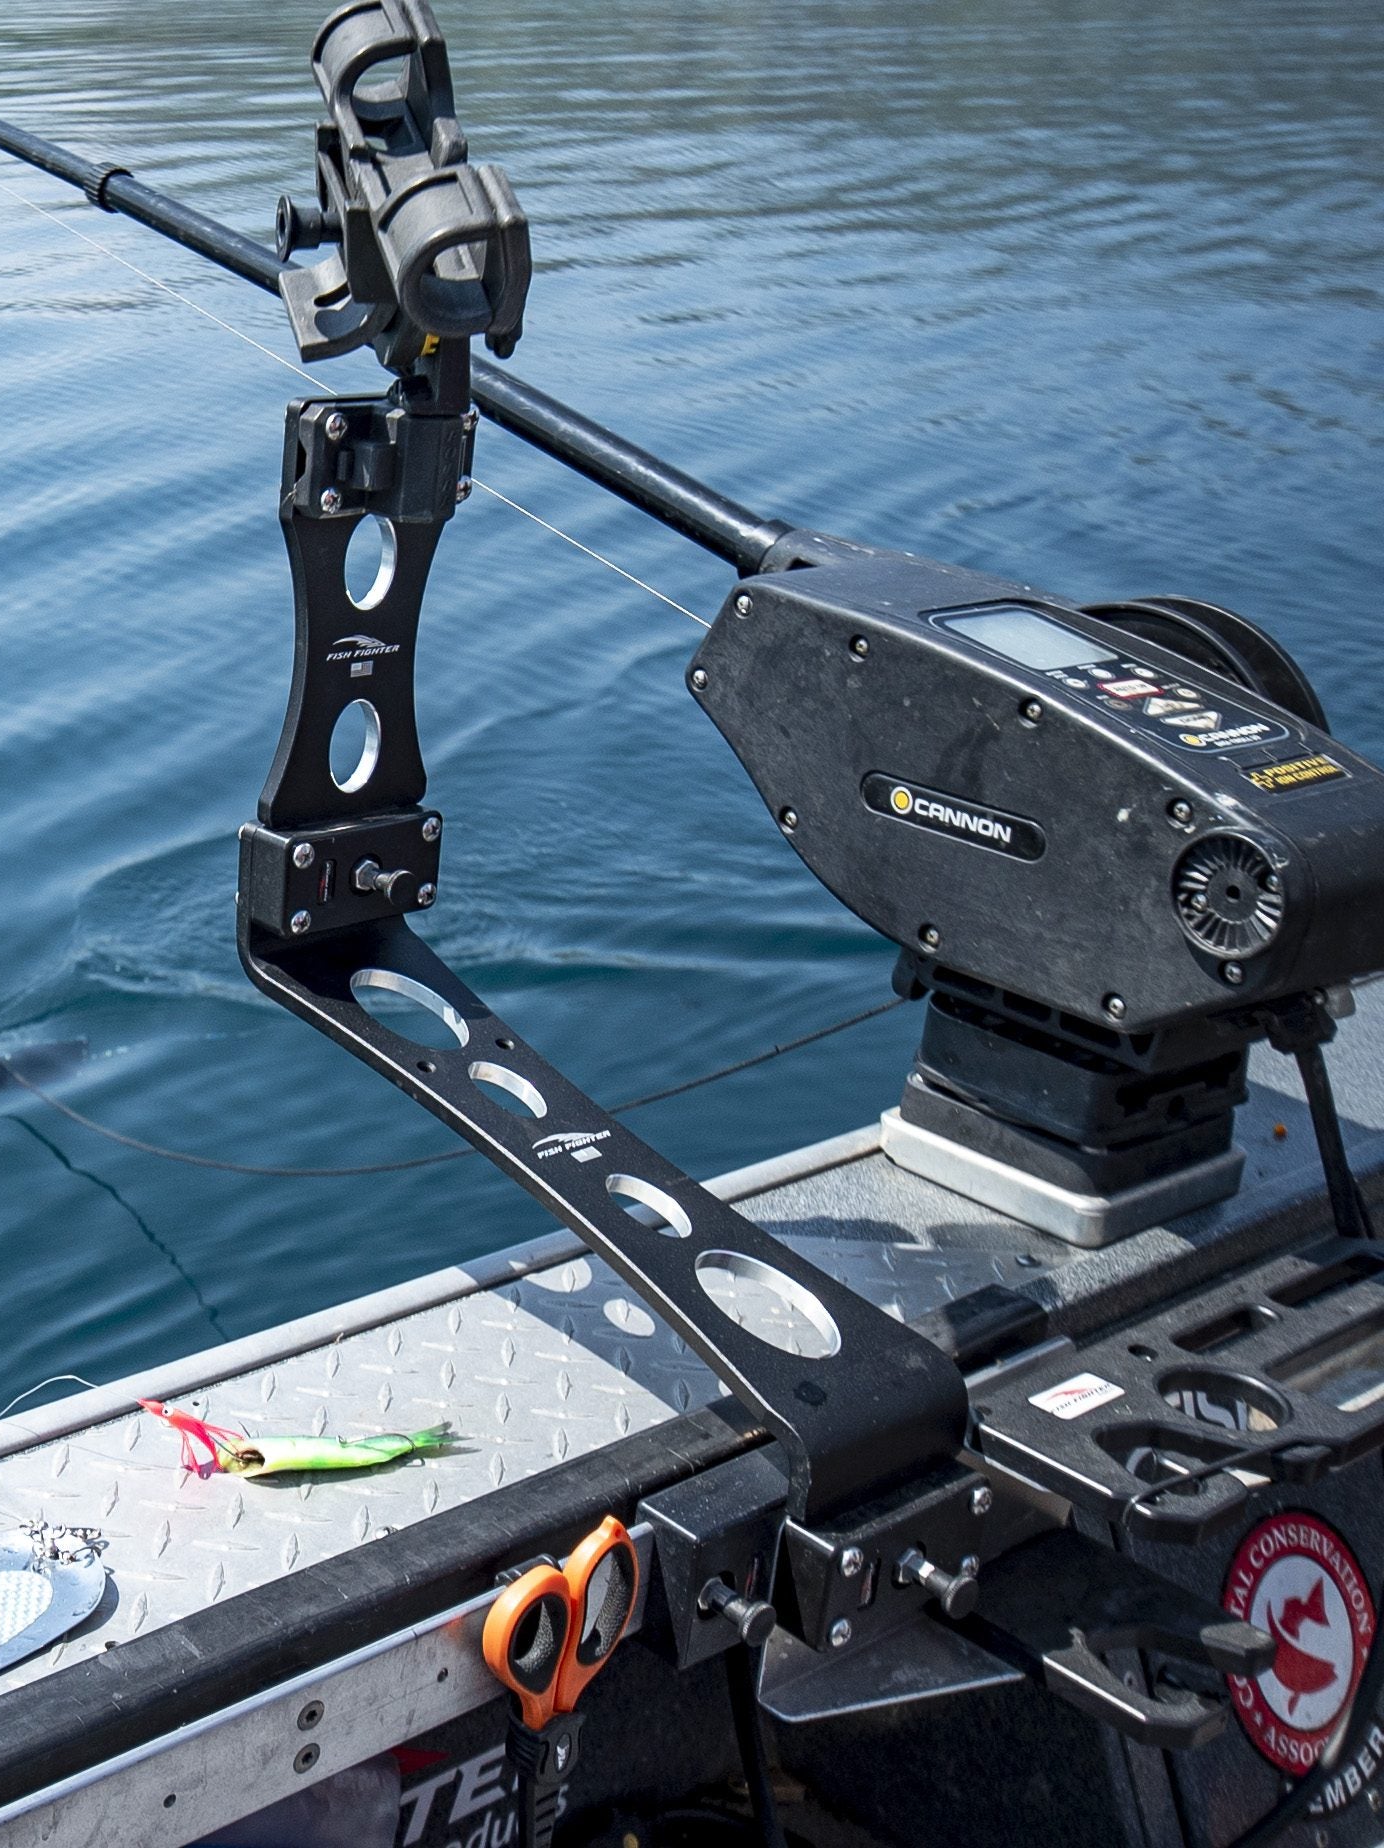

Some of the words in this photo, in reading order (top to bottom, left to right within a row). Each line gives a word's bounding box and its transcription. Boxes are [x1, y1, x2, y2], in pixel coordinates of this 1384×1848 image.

[326, 650, 352, 661] FISH
[353, 644, 400, 658] FIGHTER
[1199, 722, 1271, 742] CANNON
[914, 798, 1011, 843] CANNON
[536, 1145, 563, 1160] FISH
[564, 1129, 611, 1150] FIGHTER
[1250, 1523, 1371, 1634] CONSERVATION
